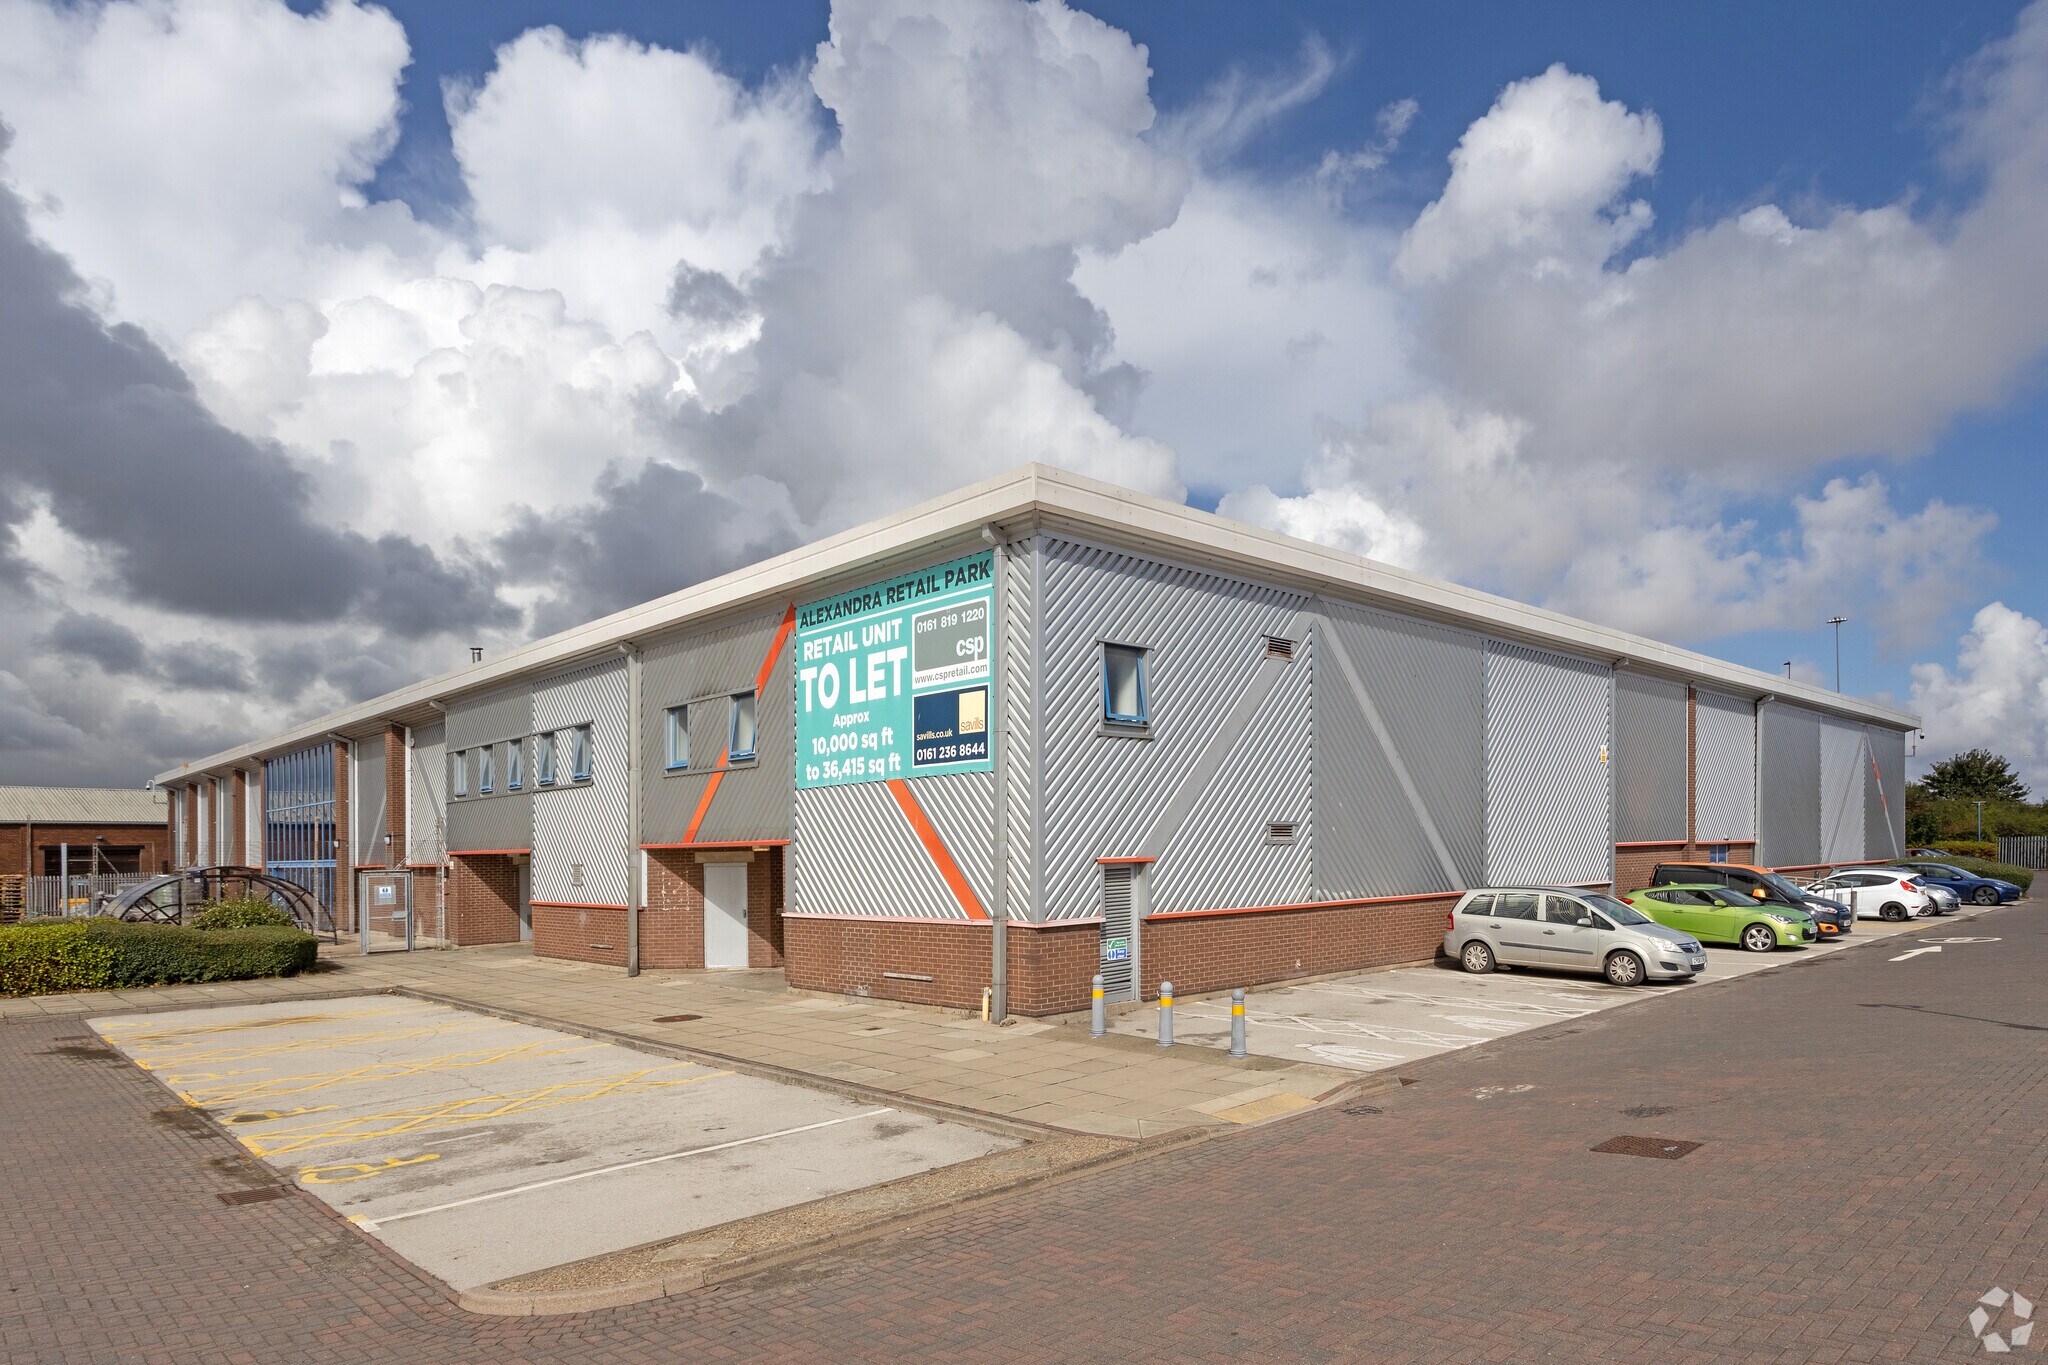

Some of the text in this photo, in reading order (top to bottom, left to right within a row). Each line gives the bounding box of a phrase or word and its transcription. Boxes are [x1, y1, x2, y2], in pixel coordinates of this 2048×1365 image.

[800, 560, 991, 628] ALEXANDRA RETAIL PARK
[917, 607, 984, 634] 0161 819 1220
[804, 618, 902, 662] RETAIL UNIT
[956, 636, 984, 661] csp
[800, 646, 908, 712] TO LET
[914, 664, 988, 684] www.cspretail.com
[832, 711, 870, 728] Approx
[960, 717, 984, 732] savills
[812, 726, 894, 756] 10,000 sq ft
[916, 728, 953, 741] savills.co.uk
[916, 742, 985, 760] 0161 236 8644
[806, 752, 901, 780] to 36,415 sq ft
